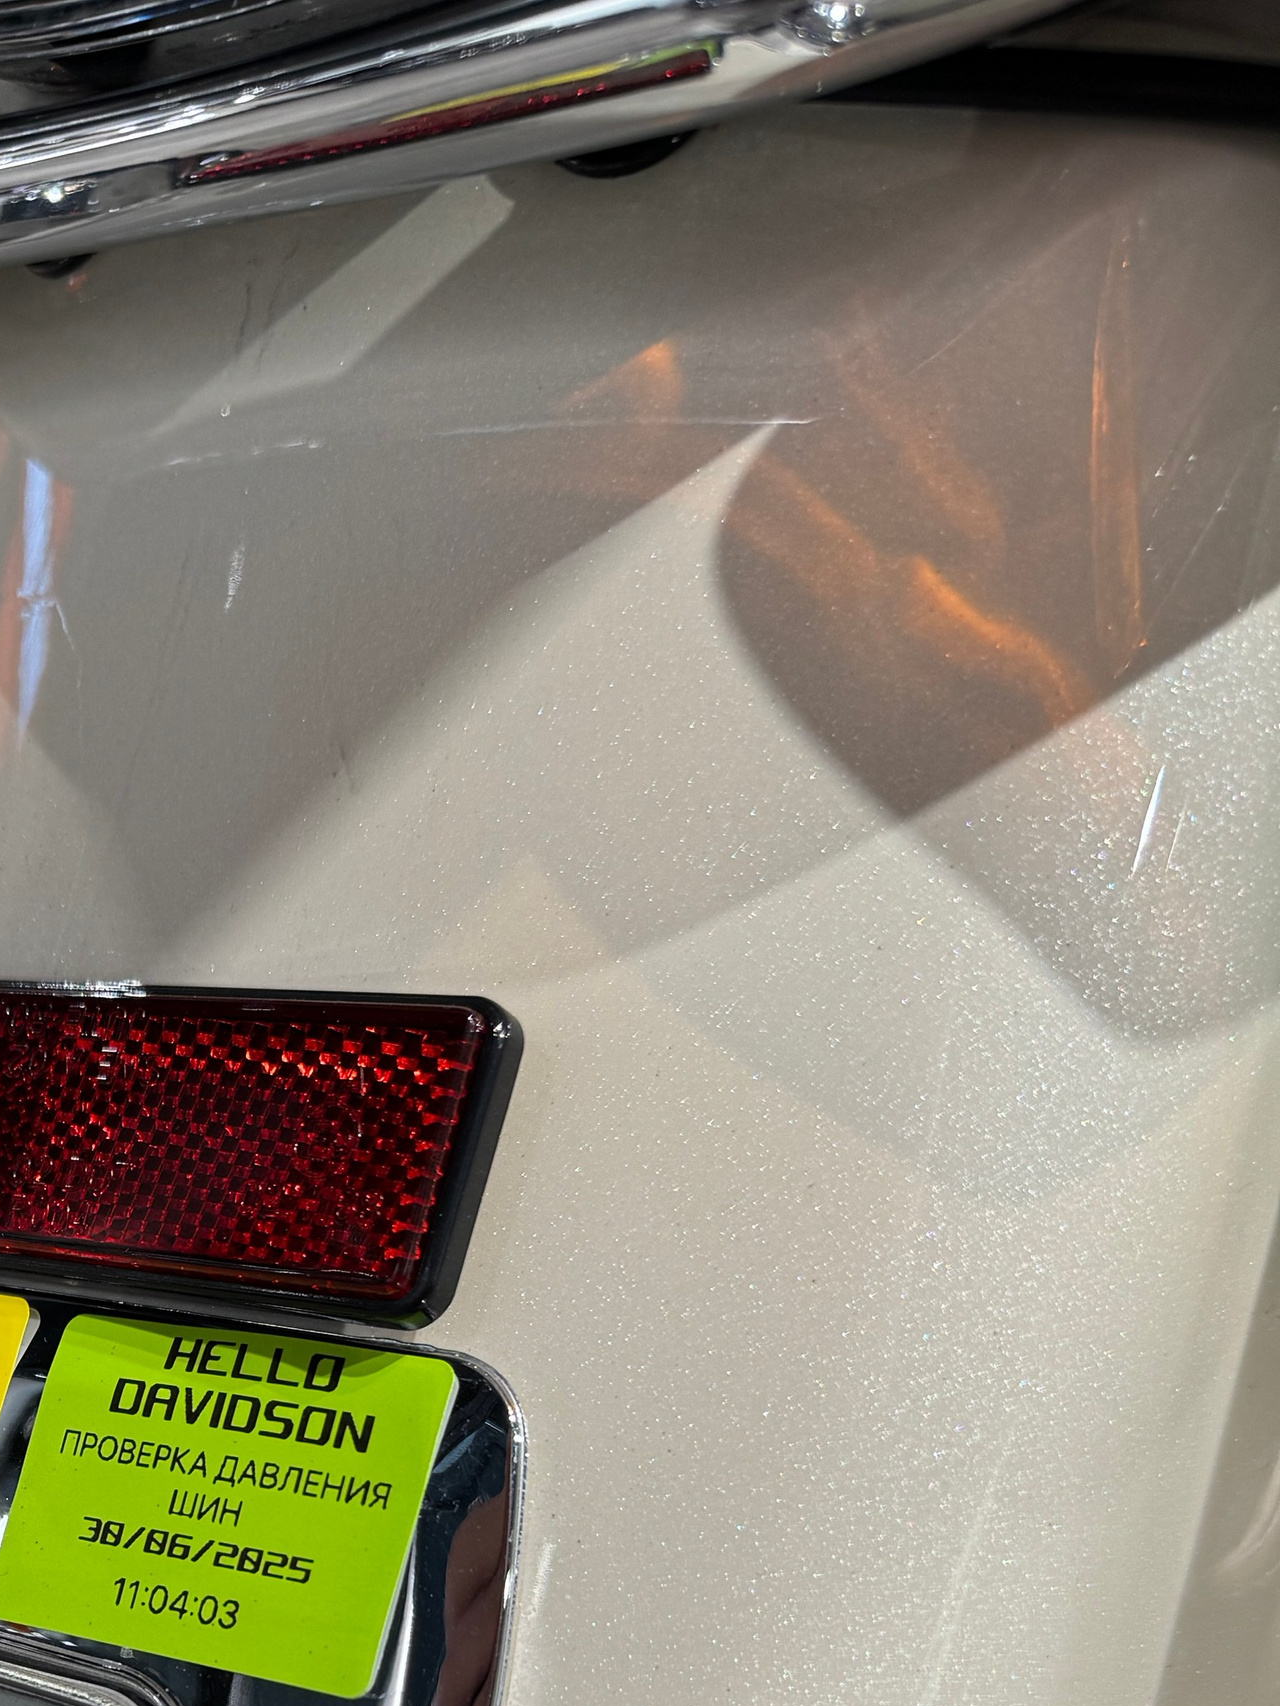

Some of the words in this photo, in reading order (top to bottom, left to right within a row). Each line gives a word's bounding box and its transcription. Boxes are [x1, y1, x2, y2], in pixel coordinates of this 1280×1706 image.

[163, 1336, 346, 1393] HELLO
[108, 1377, 376, 1454] DAVIDSON
[59, 1428, 207, 1478] ПРОВЕРКА
[212, 1455, 393, 1510] ДАВЛЕНИЯ
[168, 1488, 244, 1528] ШИН
[78, 1516, 315, 1584] 30/06/2025
[114, 1577, 240, 1630] 11:04:03
